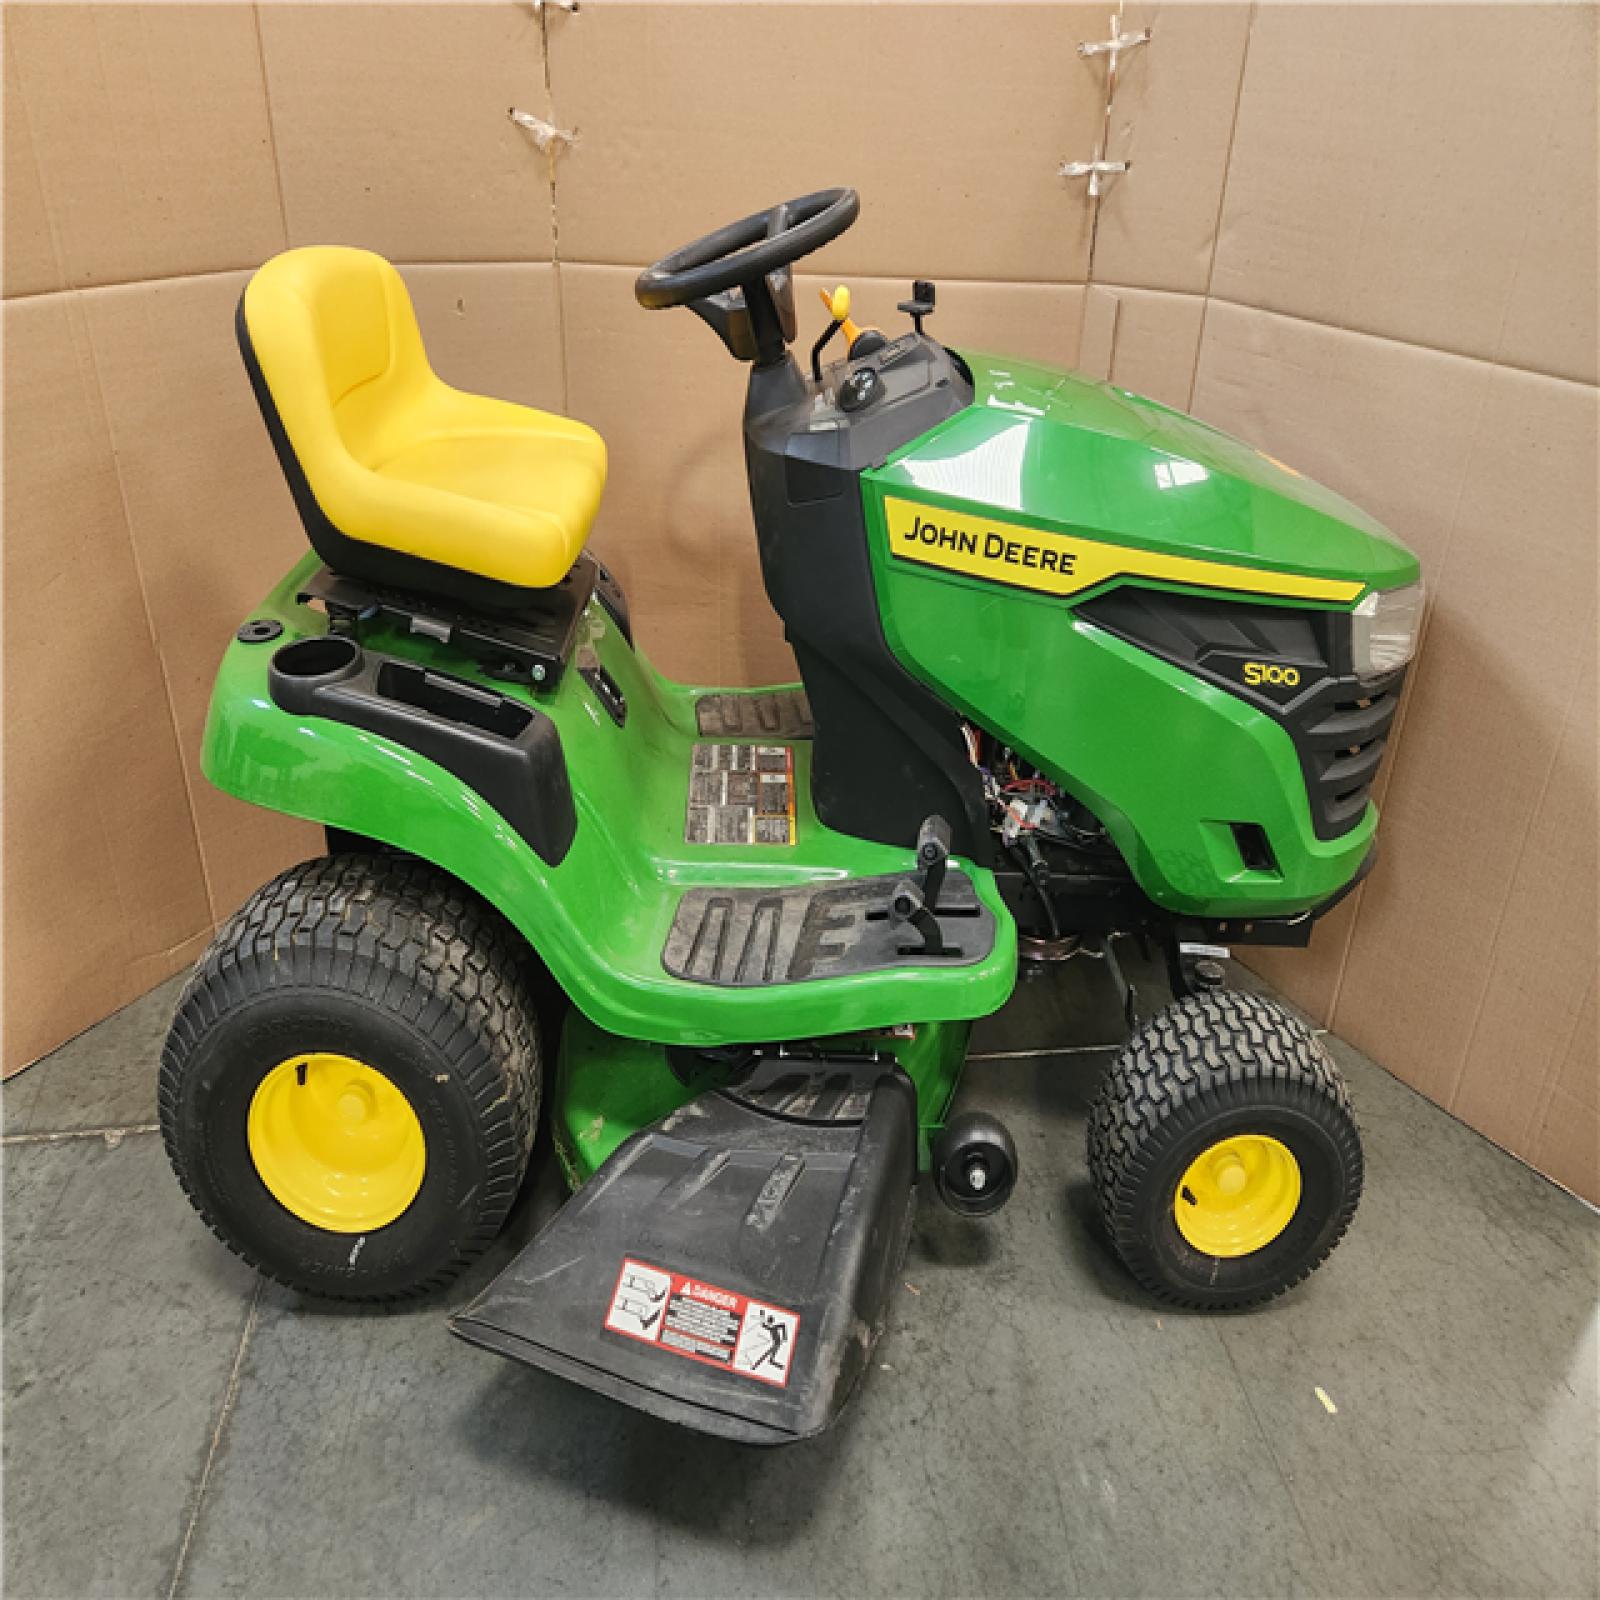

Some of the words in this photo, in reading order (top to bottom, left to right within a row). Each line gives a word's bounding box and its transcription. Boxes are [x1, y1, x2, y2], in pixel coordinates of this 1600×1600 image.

[904, 515, 978, 555] JOHN
[984, 532, 1077, 575] DEERE
[1243, 662, 1300, 686] S100
